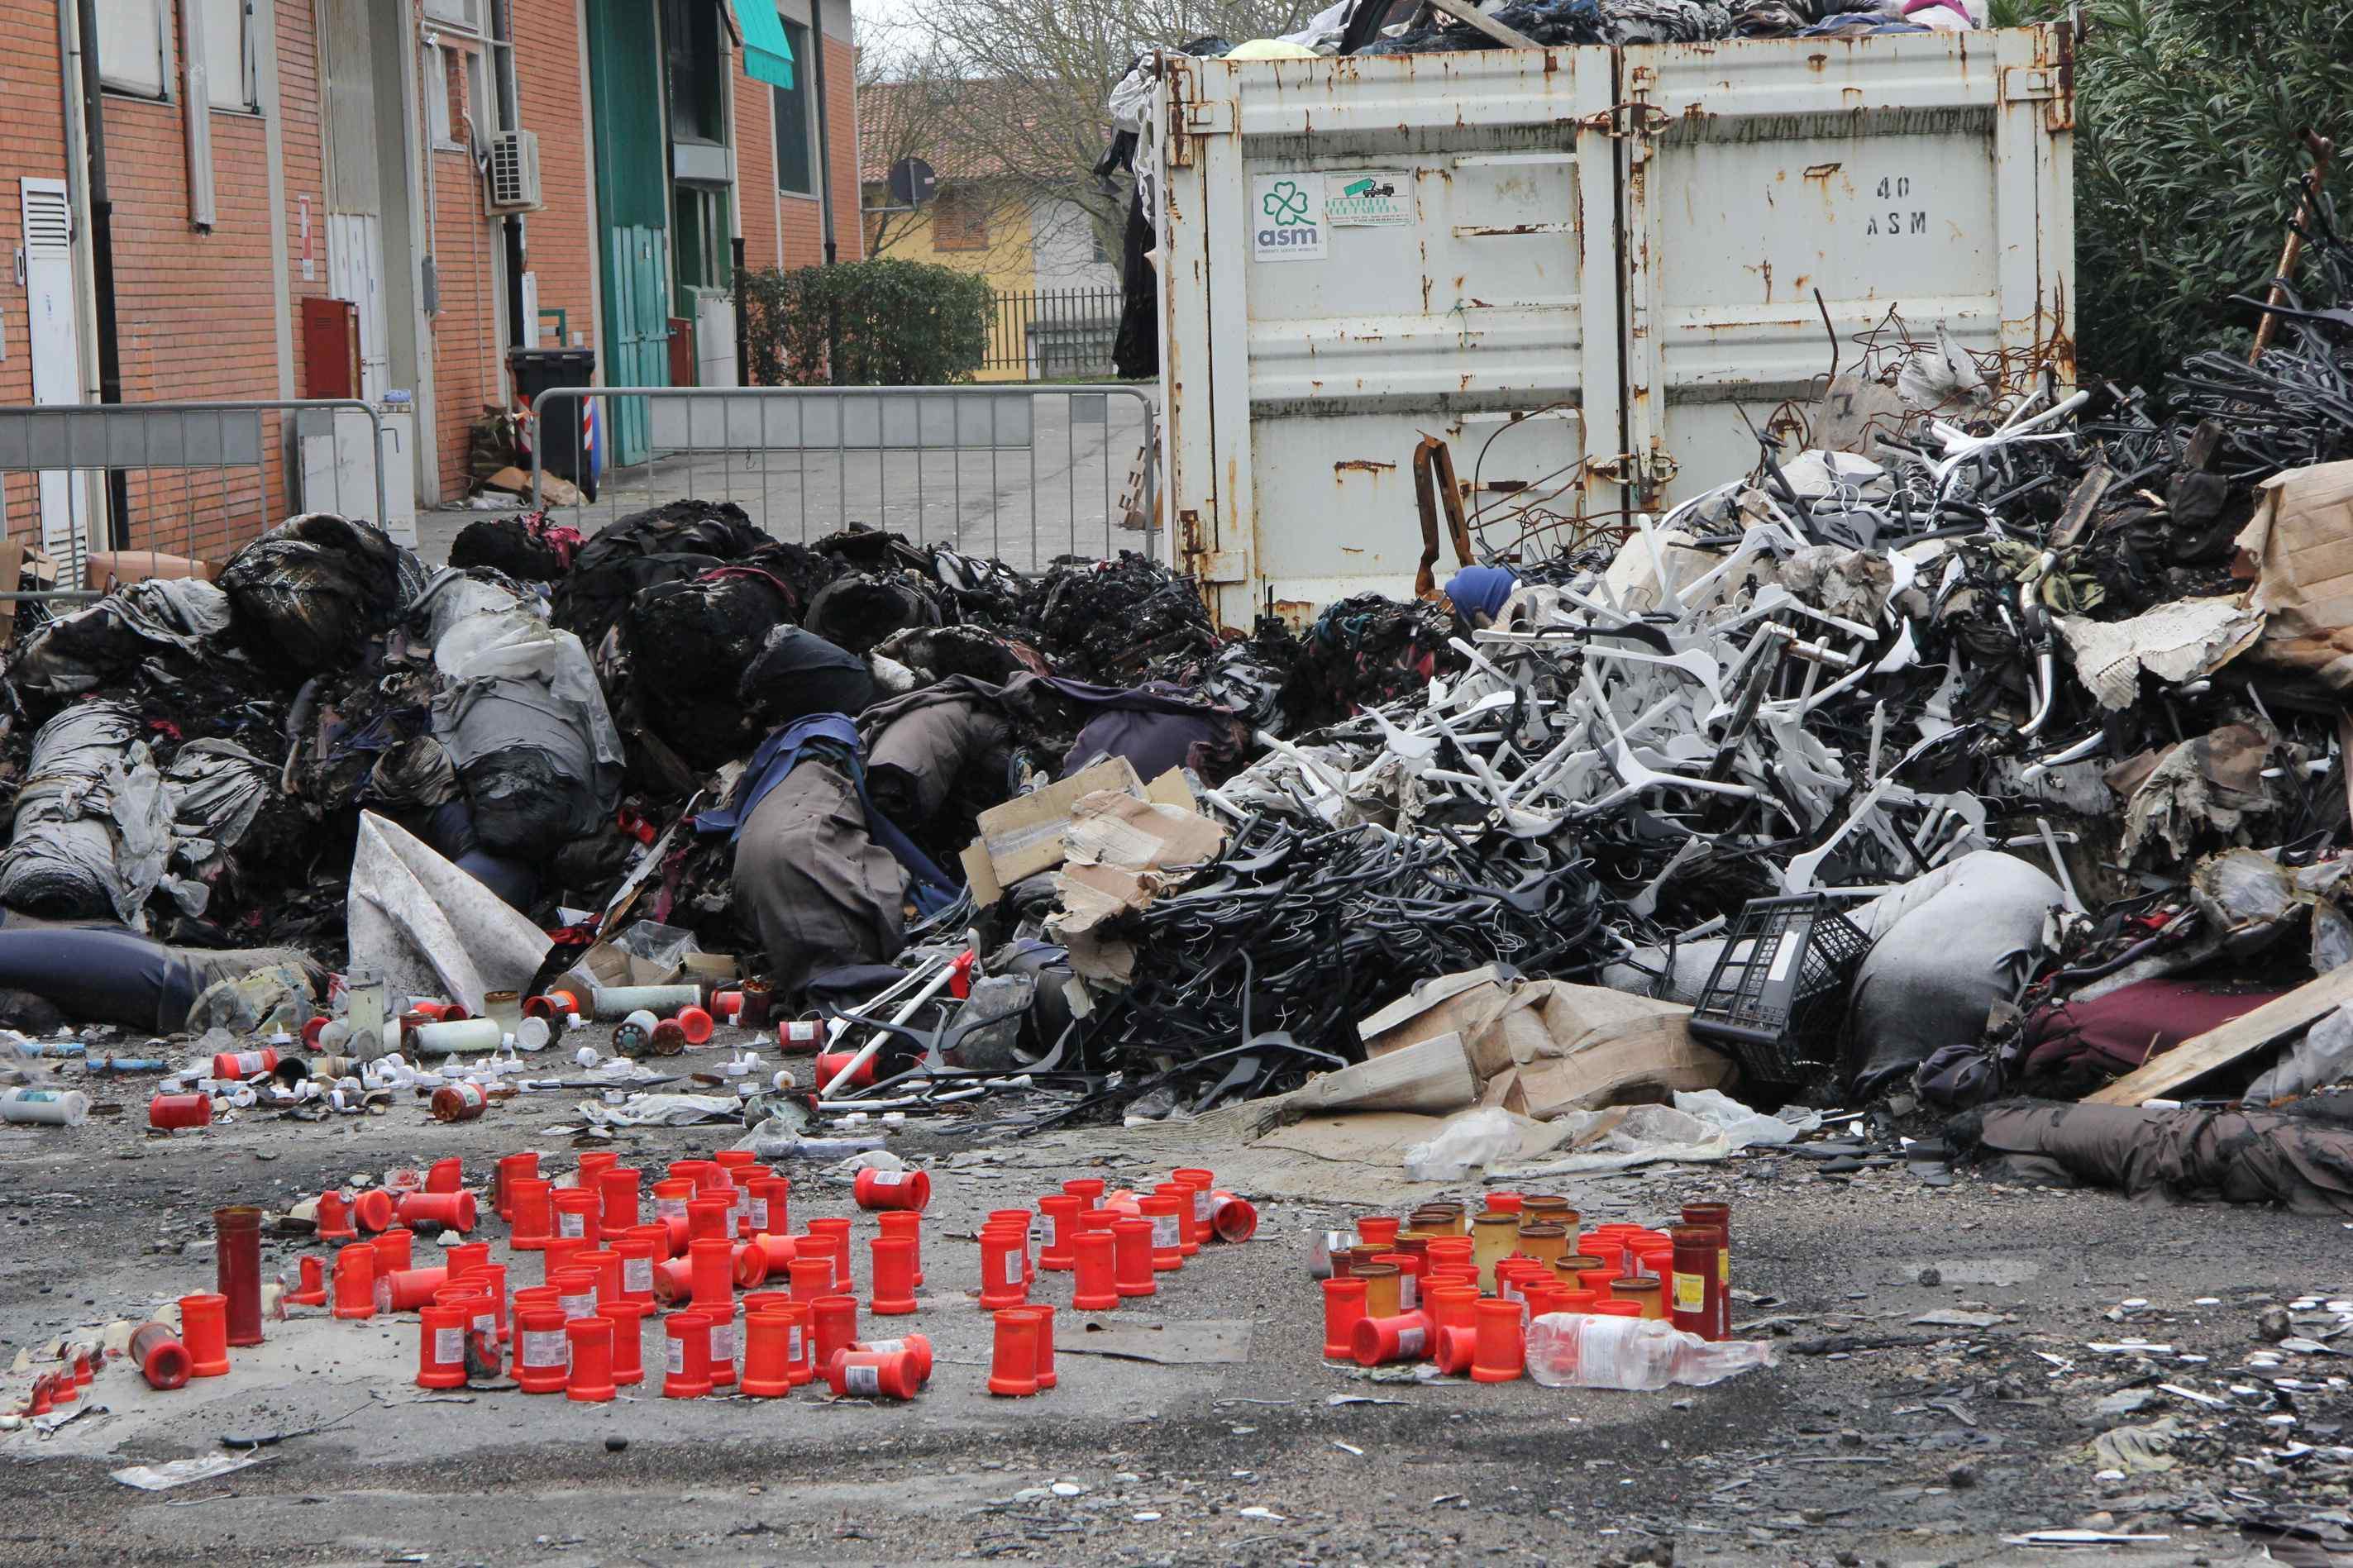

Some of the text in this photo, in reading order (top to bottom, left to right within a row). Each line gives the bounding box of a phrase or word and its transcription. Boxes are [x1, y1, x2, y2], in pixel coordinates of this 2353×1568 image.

[1877, 176, 1910, 199] 40
[1867, 212, 1926, 236] ASM
[1258, 227, 1317, 246] asm
